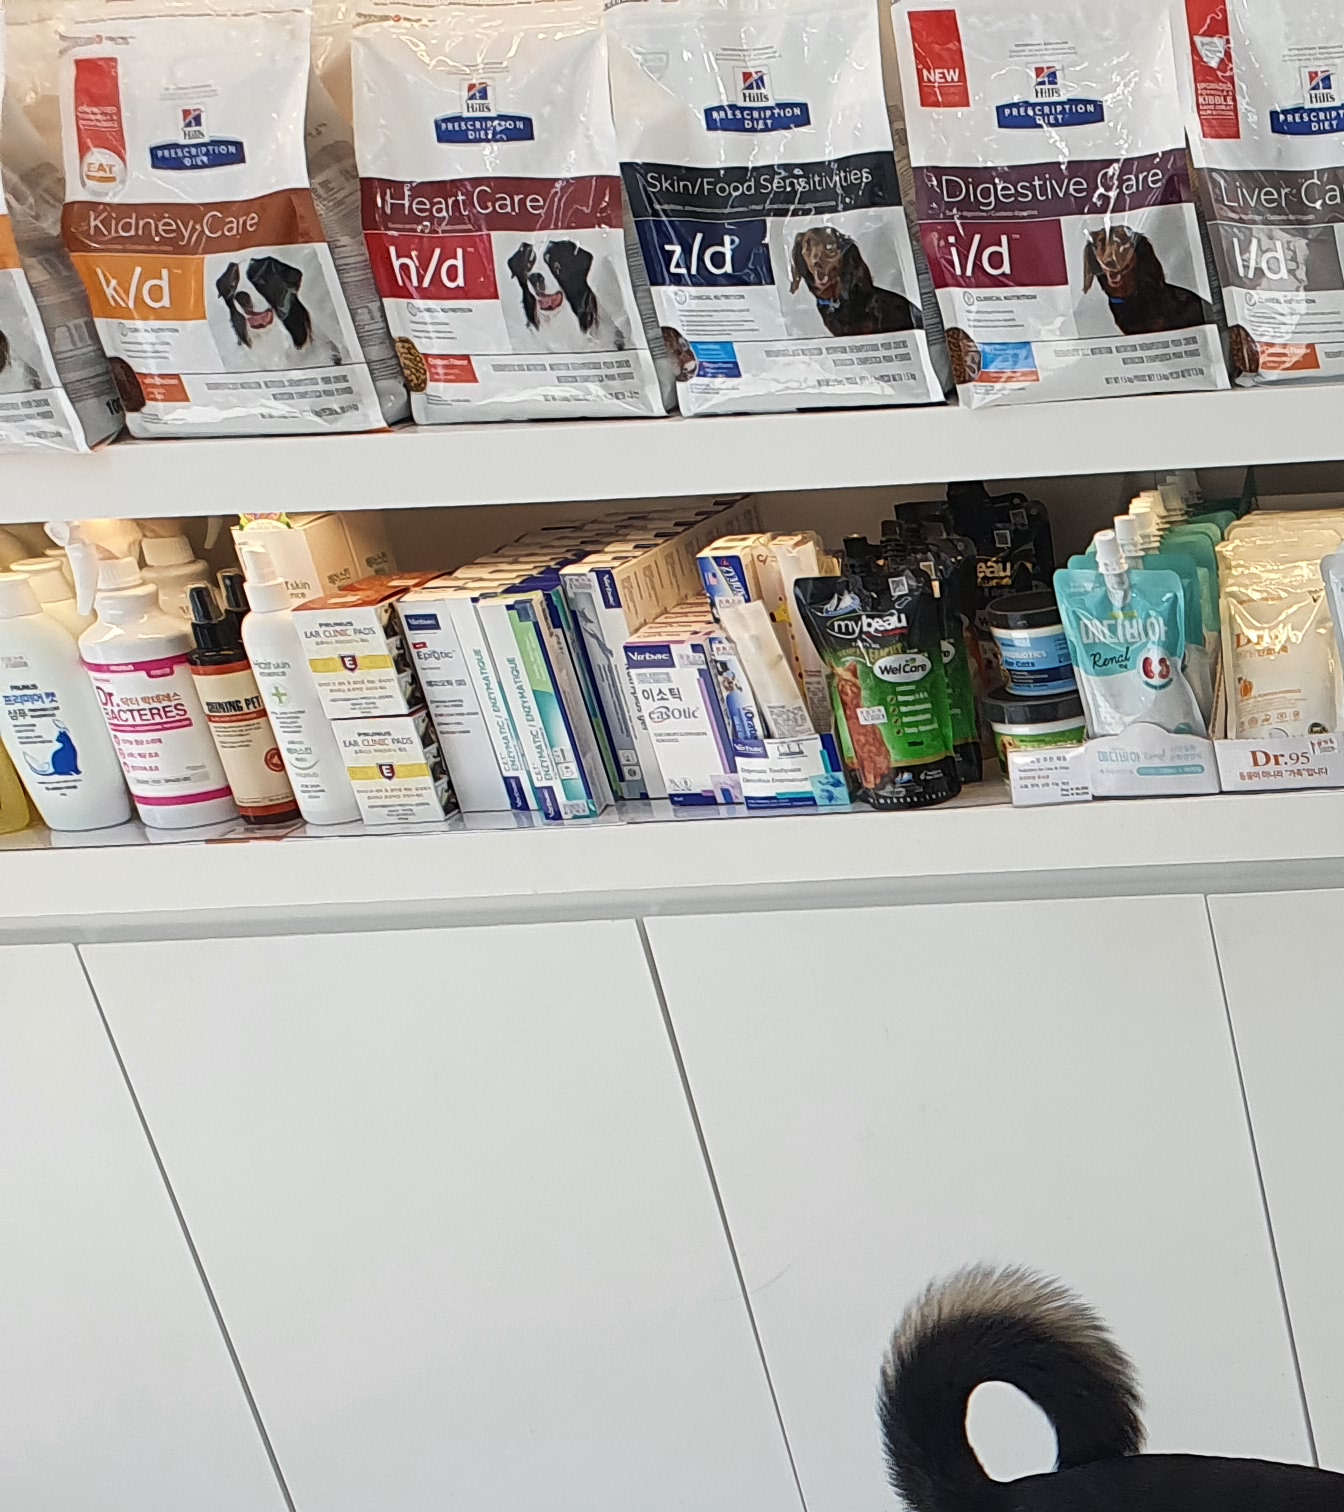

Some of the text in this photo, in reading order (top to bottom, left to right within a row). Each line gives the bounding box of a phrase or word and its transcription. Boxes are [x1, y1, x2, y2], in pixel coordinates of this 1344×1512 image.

[923, 69, 959, 82] NEW
[743, 93, 769, 102] Hill's
[1035, 88, 1061, 98] Hill's
[1309, 93, 1336, 103] Hill's
[712, 107, 801, 119] PRESCRIPTION
[1005, 105, 1095, 117] PRESCRIPTION
[441, 120, 523, 131] PRESCRIPTION
[744, 120, 773, 129] DIET
[1036, 115, 1063, 124] DIET
[1311, 121, 1337, 131] DIET
[468, 130, 492, 139] DIET
[157, 146, 236, 159] PRESCRIPTION
[647, 168, 872, 197] Skin/Food Sensitivities
[942, 163, 1162, 210] Digestive Care
[1222, 182, 1291, 207] Liver
[386, 187, 544, 217] Heart Care
[89, 211, 259, 245] Kidney Care
[664, 233, 734, 275] z/d
[948, 234, 1011, 277] i/d
[1233, 237, 1288, 280] l/d
[389, 246, 465, 288] h/d
[96, 266, 170, 310] k/d
[834, 612, 907, 635] mybeau
[347, 657, 354, 667] E
[627, 651, 670, 661] Virbac
[1091, 647, 1130, 669] Renal
[642, 687, 683, 702] 이소틱
[1250, 749, 1310, 767] Dr.95
[383, 765, 392, 776] E
